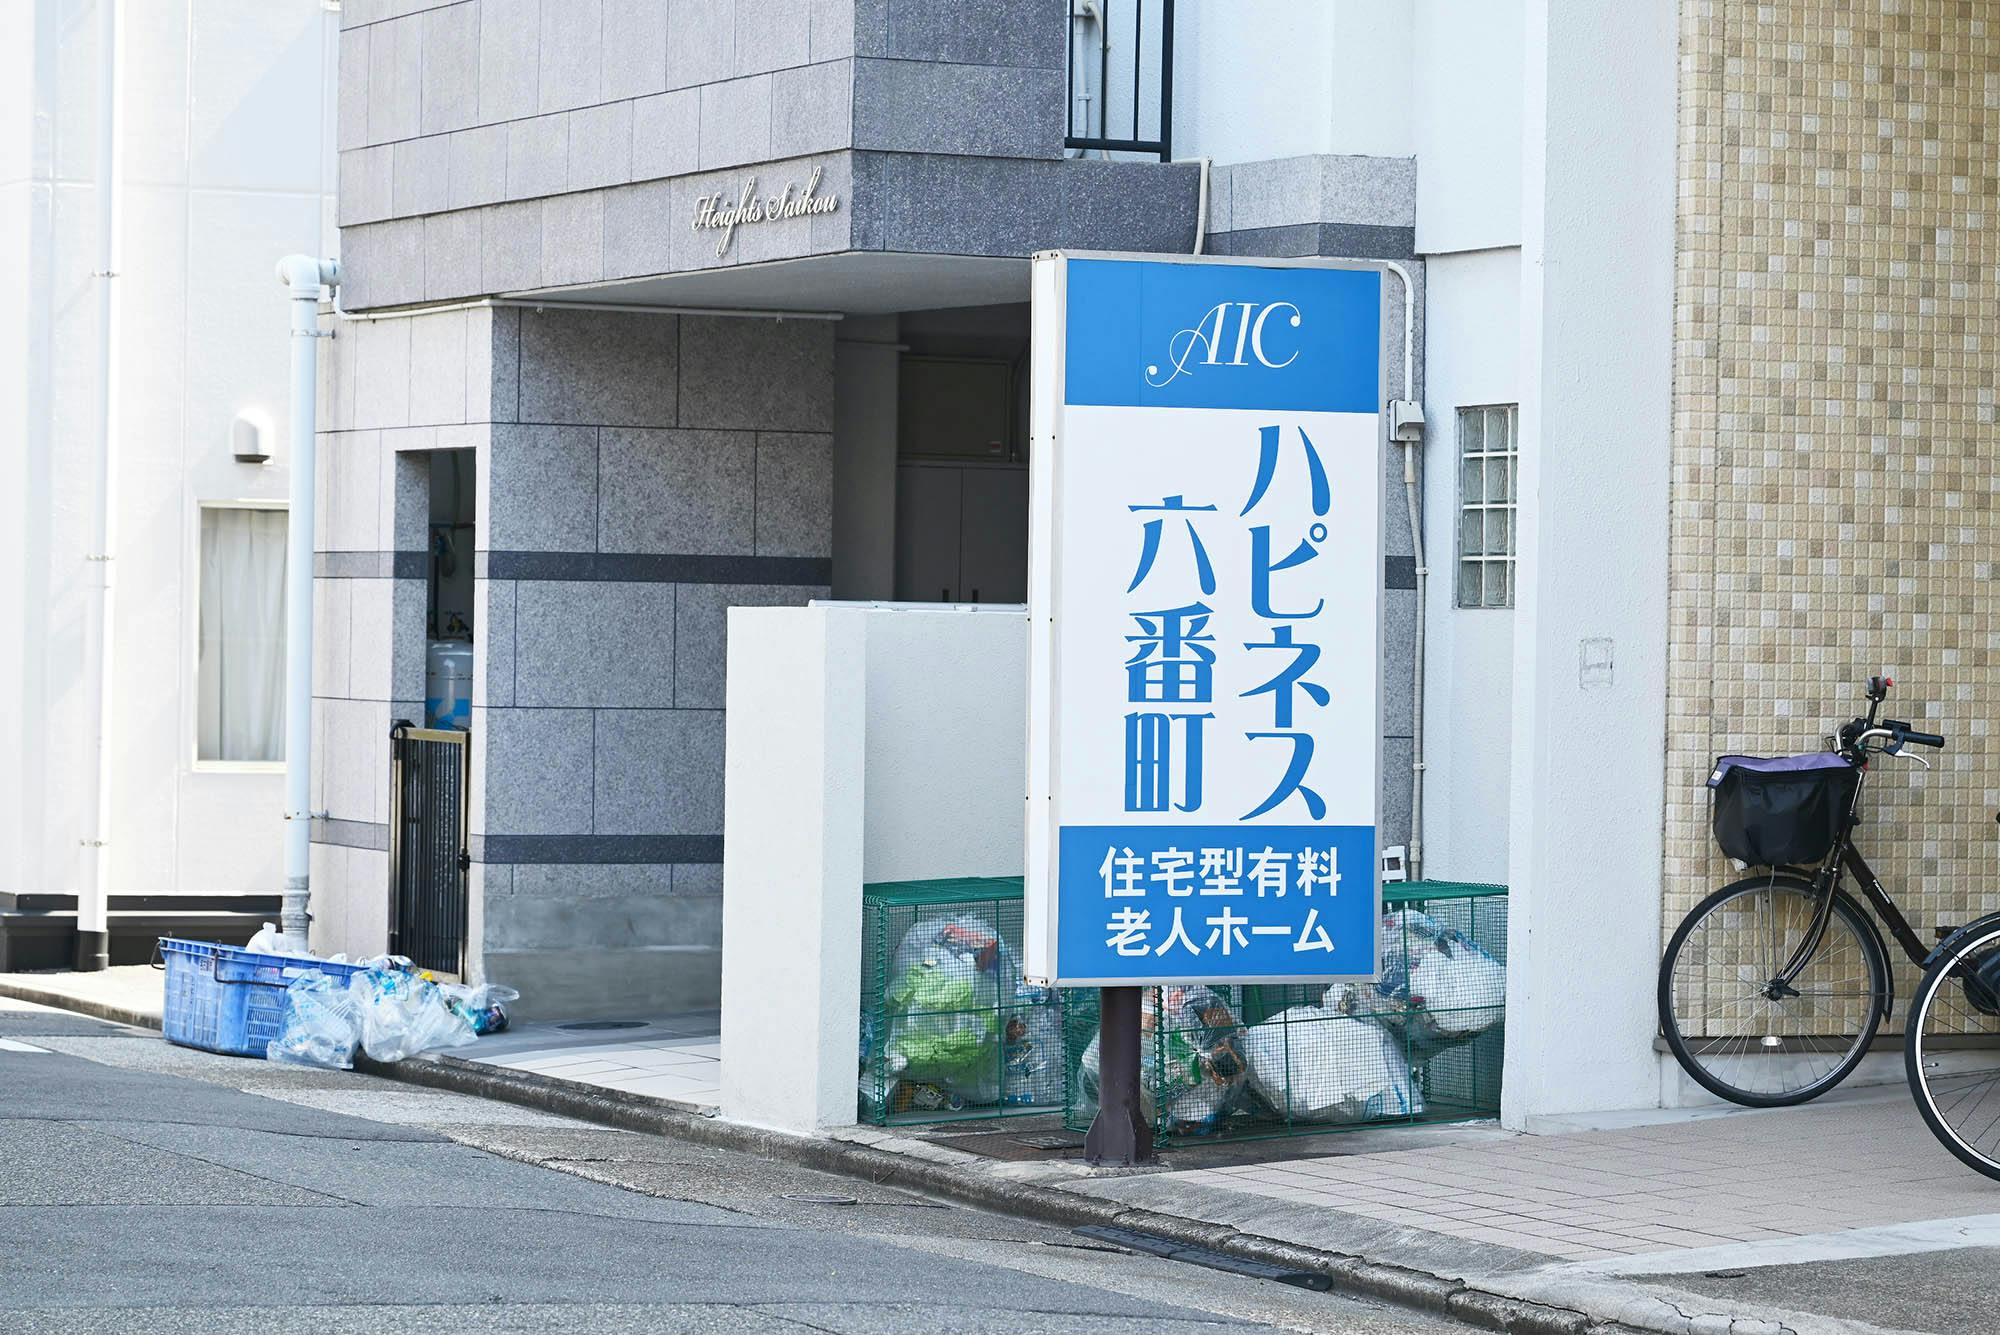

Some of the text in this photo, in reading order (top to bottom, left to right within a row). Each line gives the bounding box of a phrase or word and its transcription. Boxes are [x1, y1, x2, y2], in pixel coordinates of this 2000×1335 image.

[693, 166, 837, 257] Heights Saikou
[1146, 302, 1300, 388] AIC
[1125, 495, 1217, 812] 六番町
[1239, 426, 1330, 820] ハピネス
[1099, 846, 1341, 897] 住宅型有料
[1106, 907, 1334, 956] 老人ホーム
